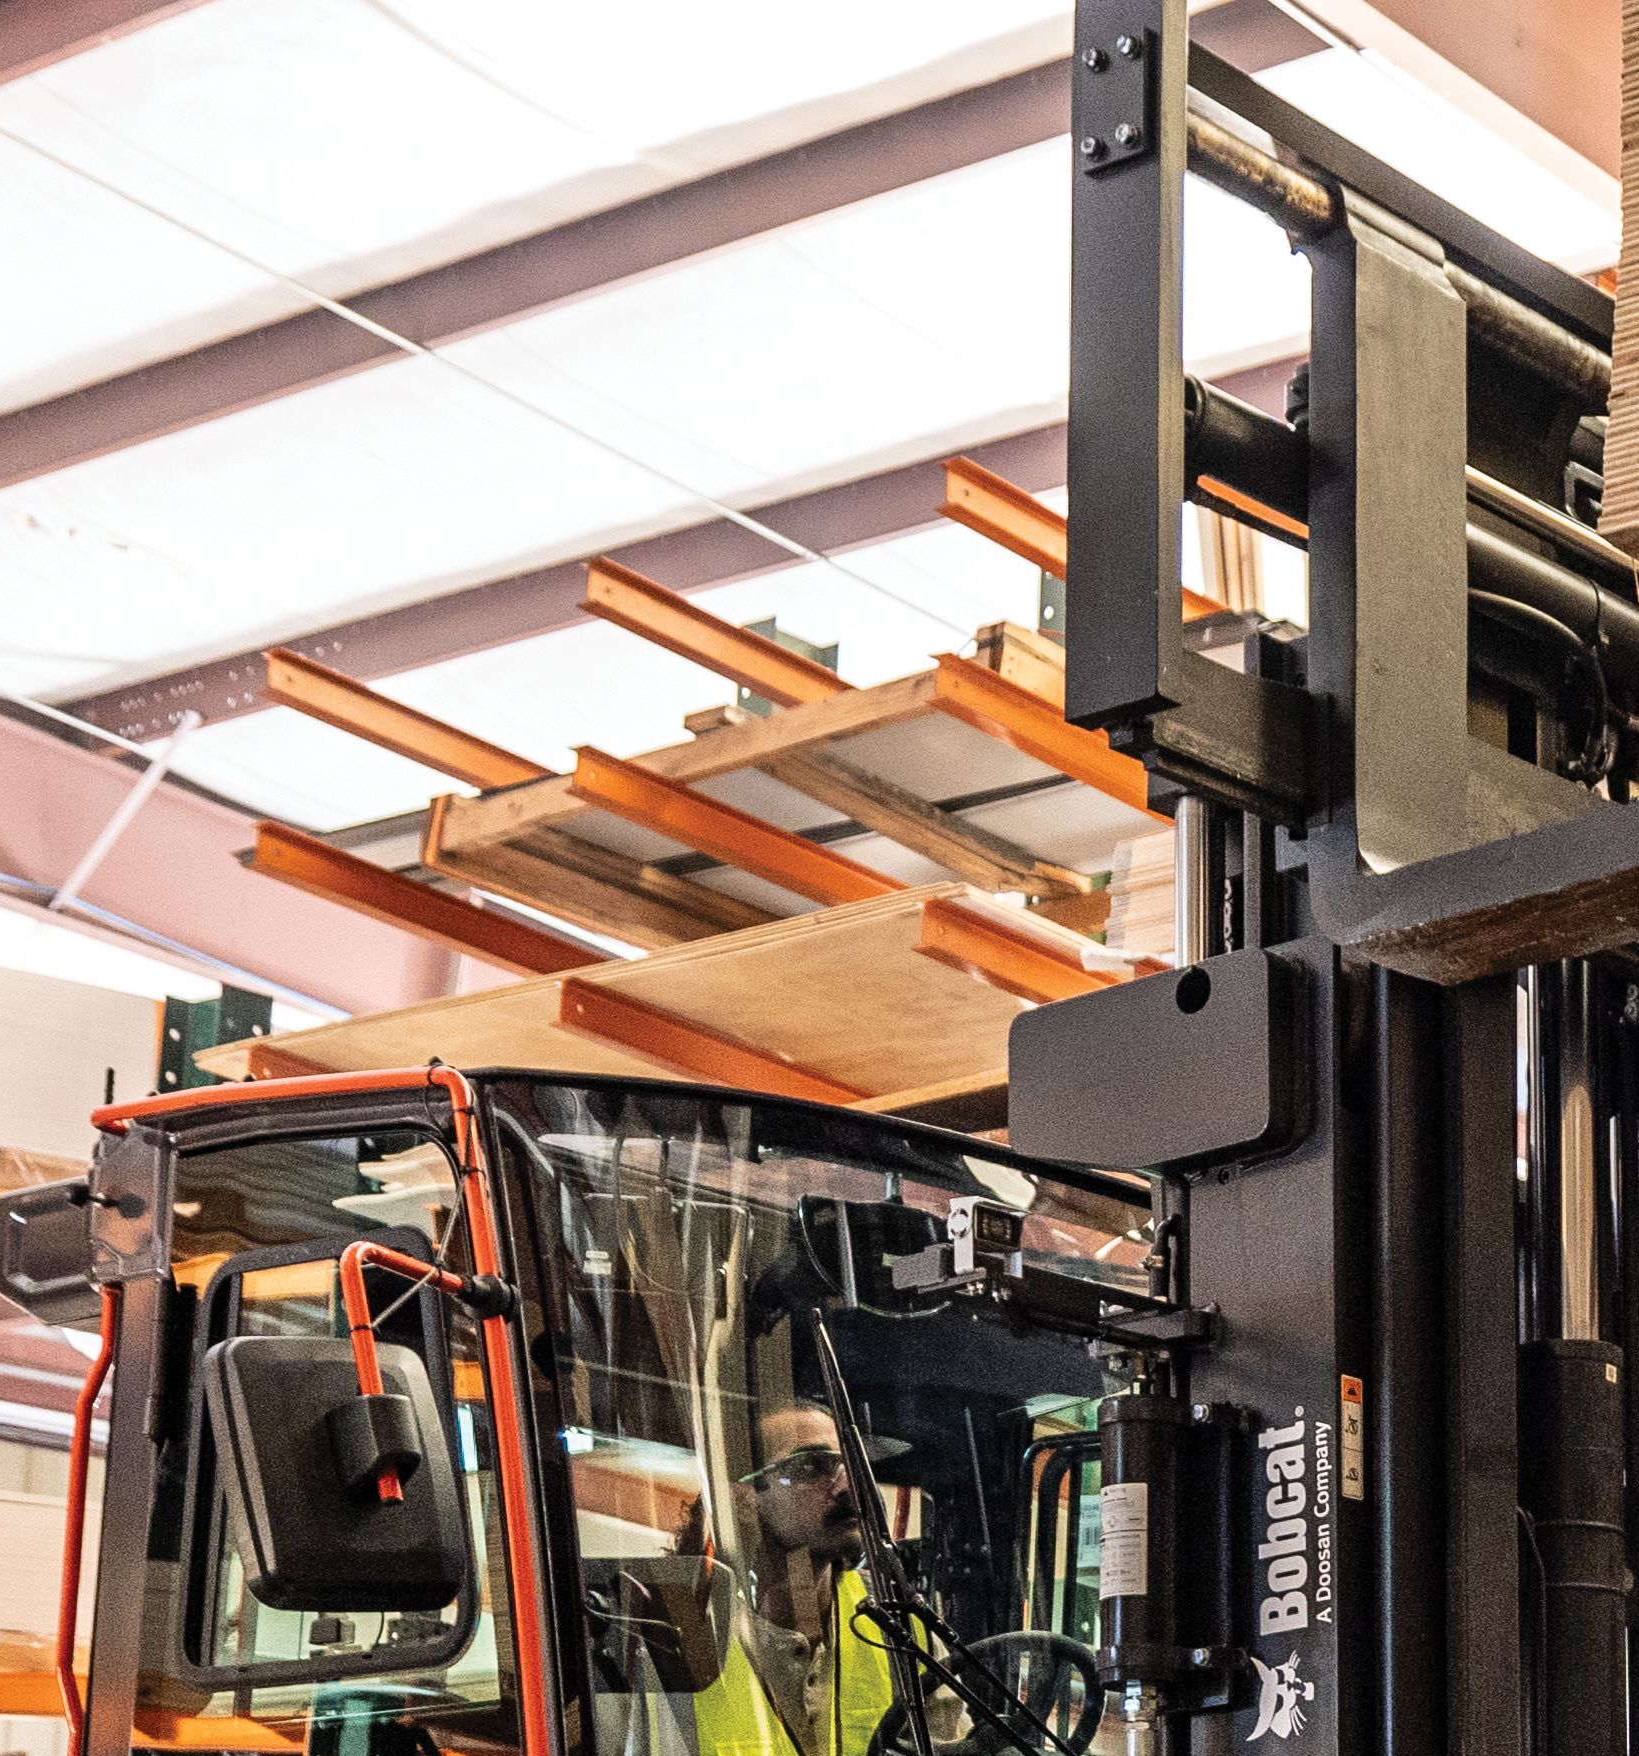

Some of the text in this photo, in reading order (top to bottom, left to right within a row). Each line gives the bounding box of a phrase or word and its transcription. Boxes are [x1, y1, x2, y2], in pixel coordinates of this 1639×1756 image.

[1258, 1419, 1309, 1636] Bobcat
[1314, 1420, 1332, 1623] A Doosan Company
